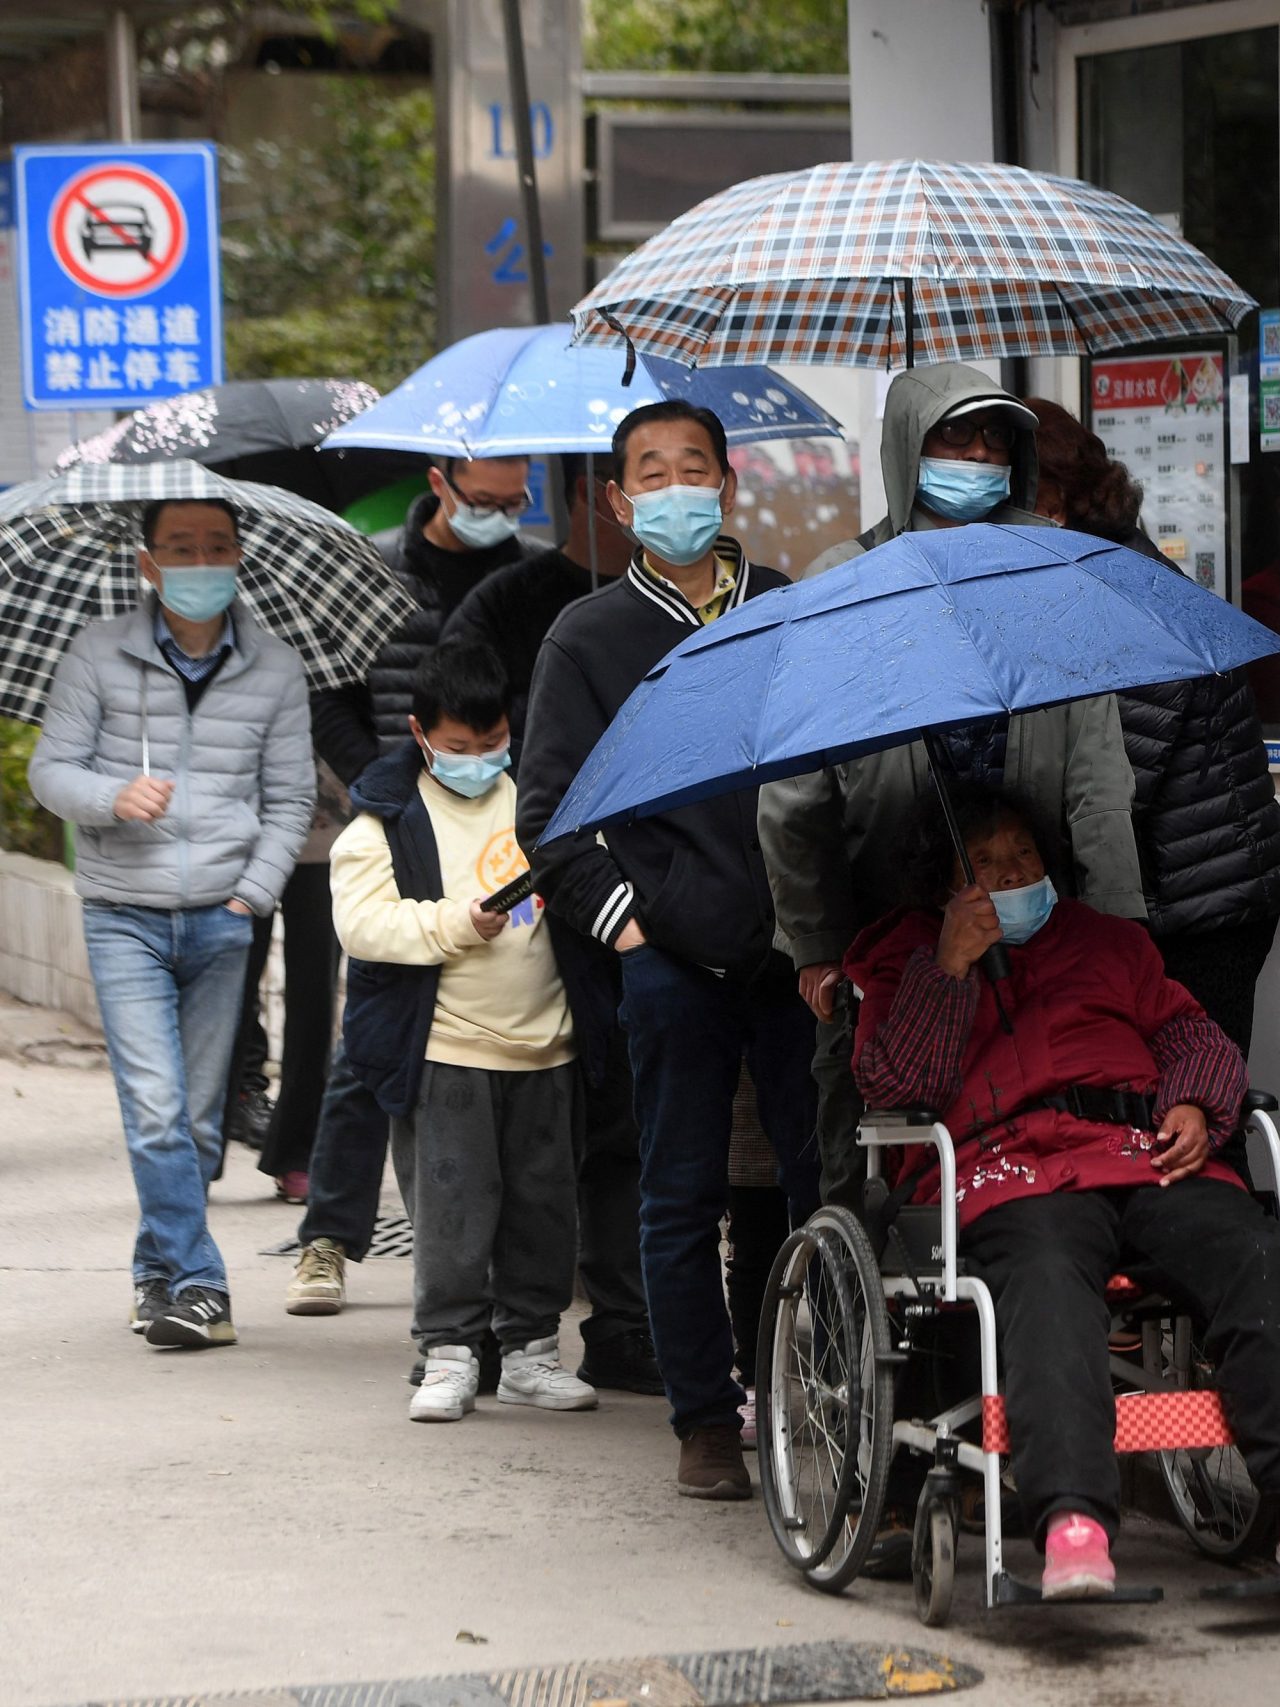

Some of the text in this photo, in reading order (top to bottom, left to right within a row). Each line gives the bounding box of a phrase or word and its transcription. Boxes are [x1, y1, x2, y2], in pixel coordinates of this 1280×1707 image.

[43, 303, 201, 347] 消防通道
[44, 348, 202, 391] 禁止停车
